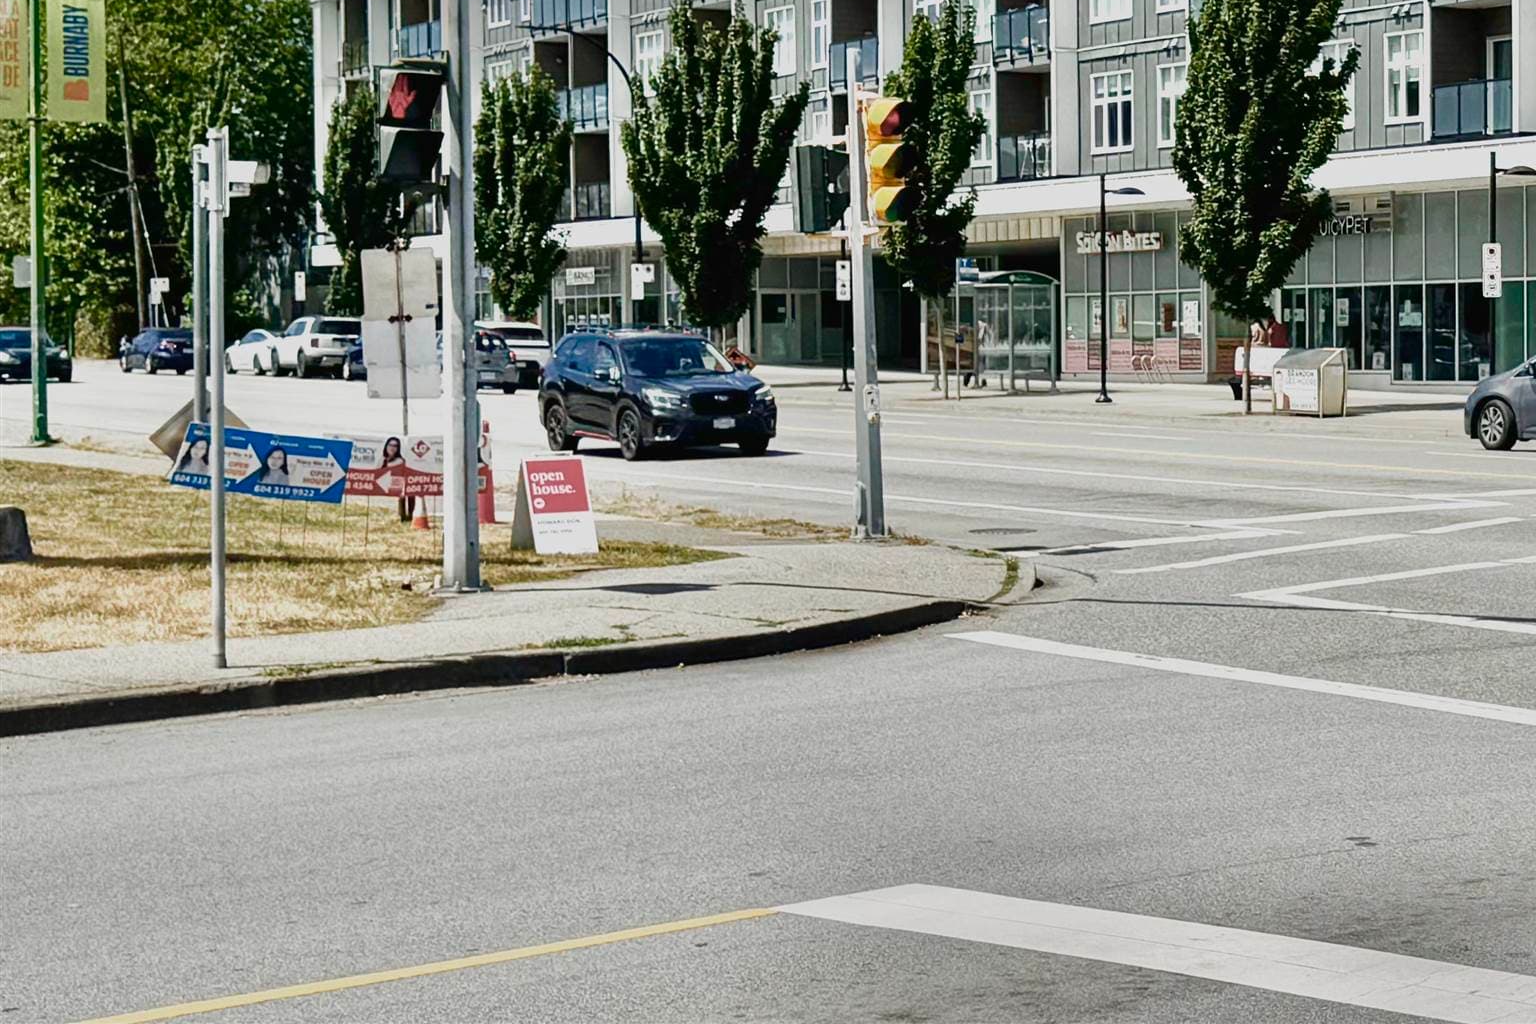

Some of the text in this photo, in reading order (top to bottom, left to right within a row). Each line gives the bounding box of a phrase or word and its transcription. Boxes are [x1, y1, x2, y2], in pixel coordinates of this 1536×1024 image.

[62, 3, 90, 77] BURNABY
[1319, 215, 1369, 236] UICYPET
[310, 470, 333, 478] OPEN
[530, 471, 565, 485] open
[302, 477, 331, 486] HOUSE
[407, 476, 430, 484] OPEN
[254, 484, 272, 494] 604
[531, 483, 577, 495] house.
